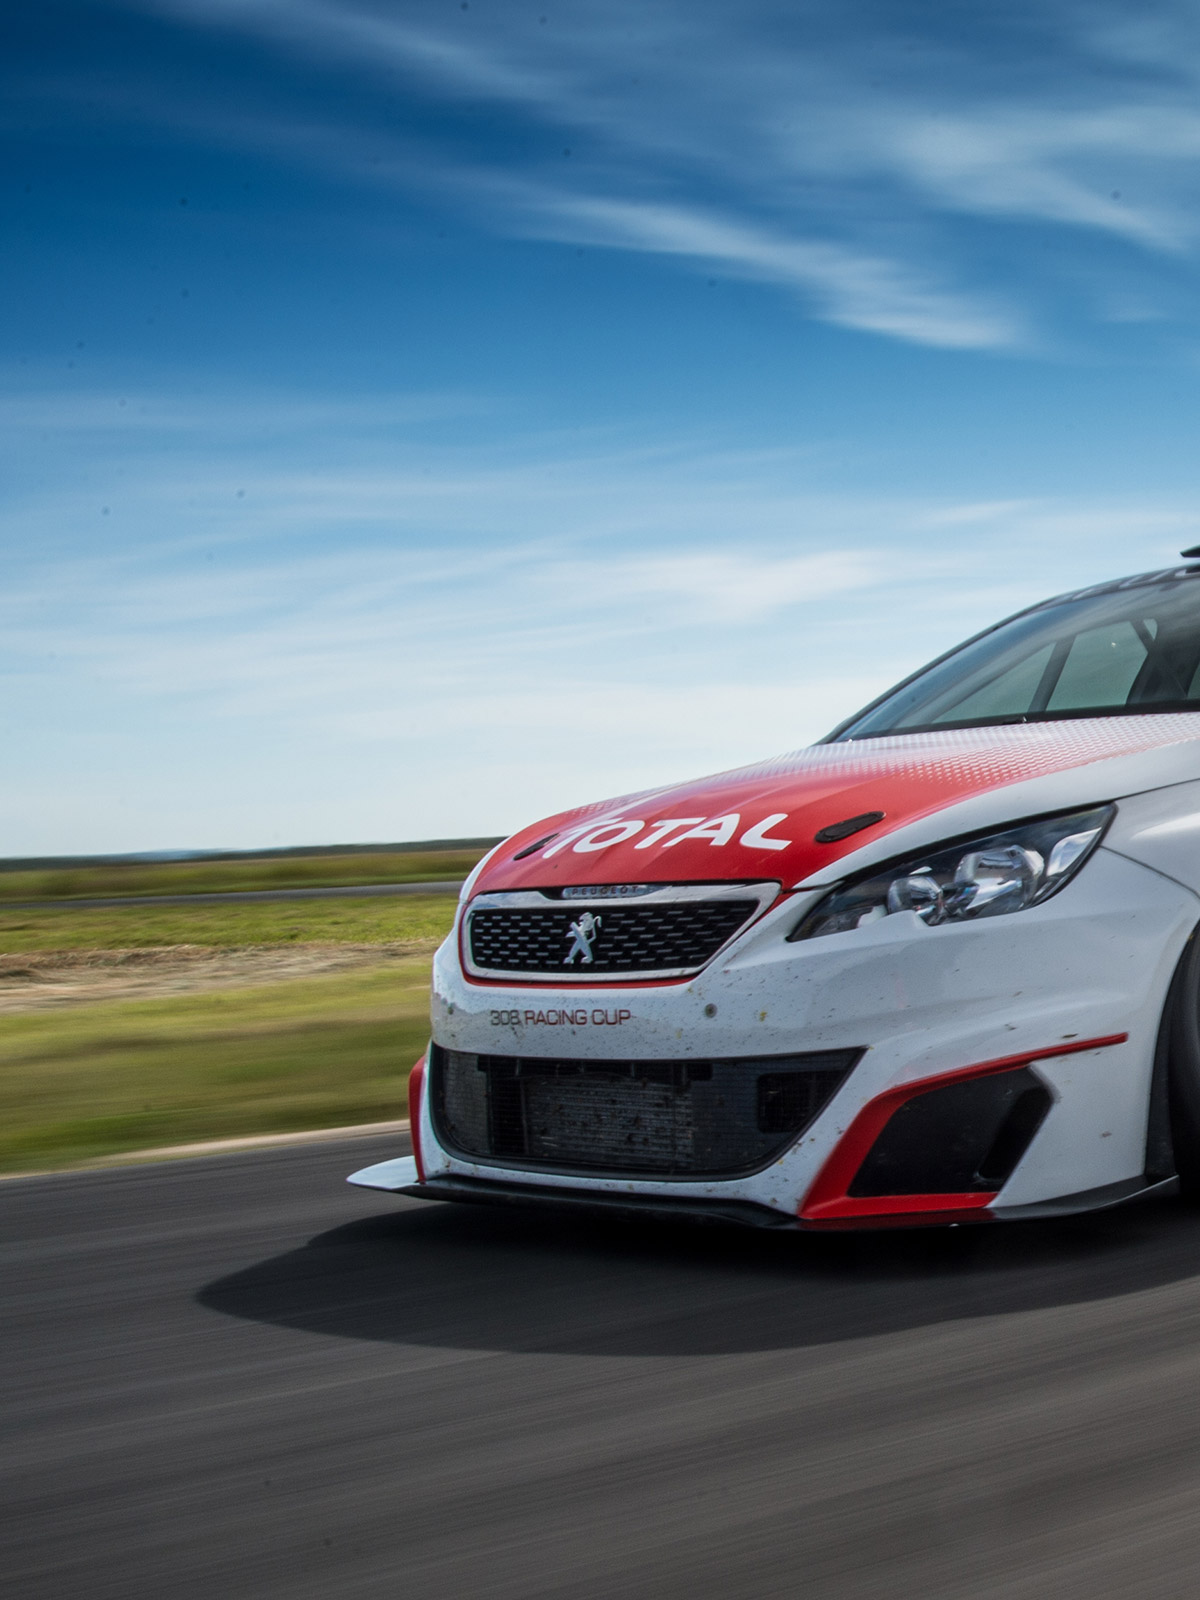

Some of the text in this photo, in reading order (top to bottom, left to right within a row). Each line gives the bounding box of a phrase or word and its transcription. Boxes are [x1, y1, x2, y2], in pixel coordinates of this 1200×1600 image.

[542, 813, 793, 859] TOTAL
[572, 885, 638, 895] PEUGEOT
[490, 1009, 631, 1026] 308 RACING CUP
